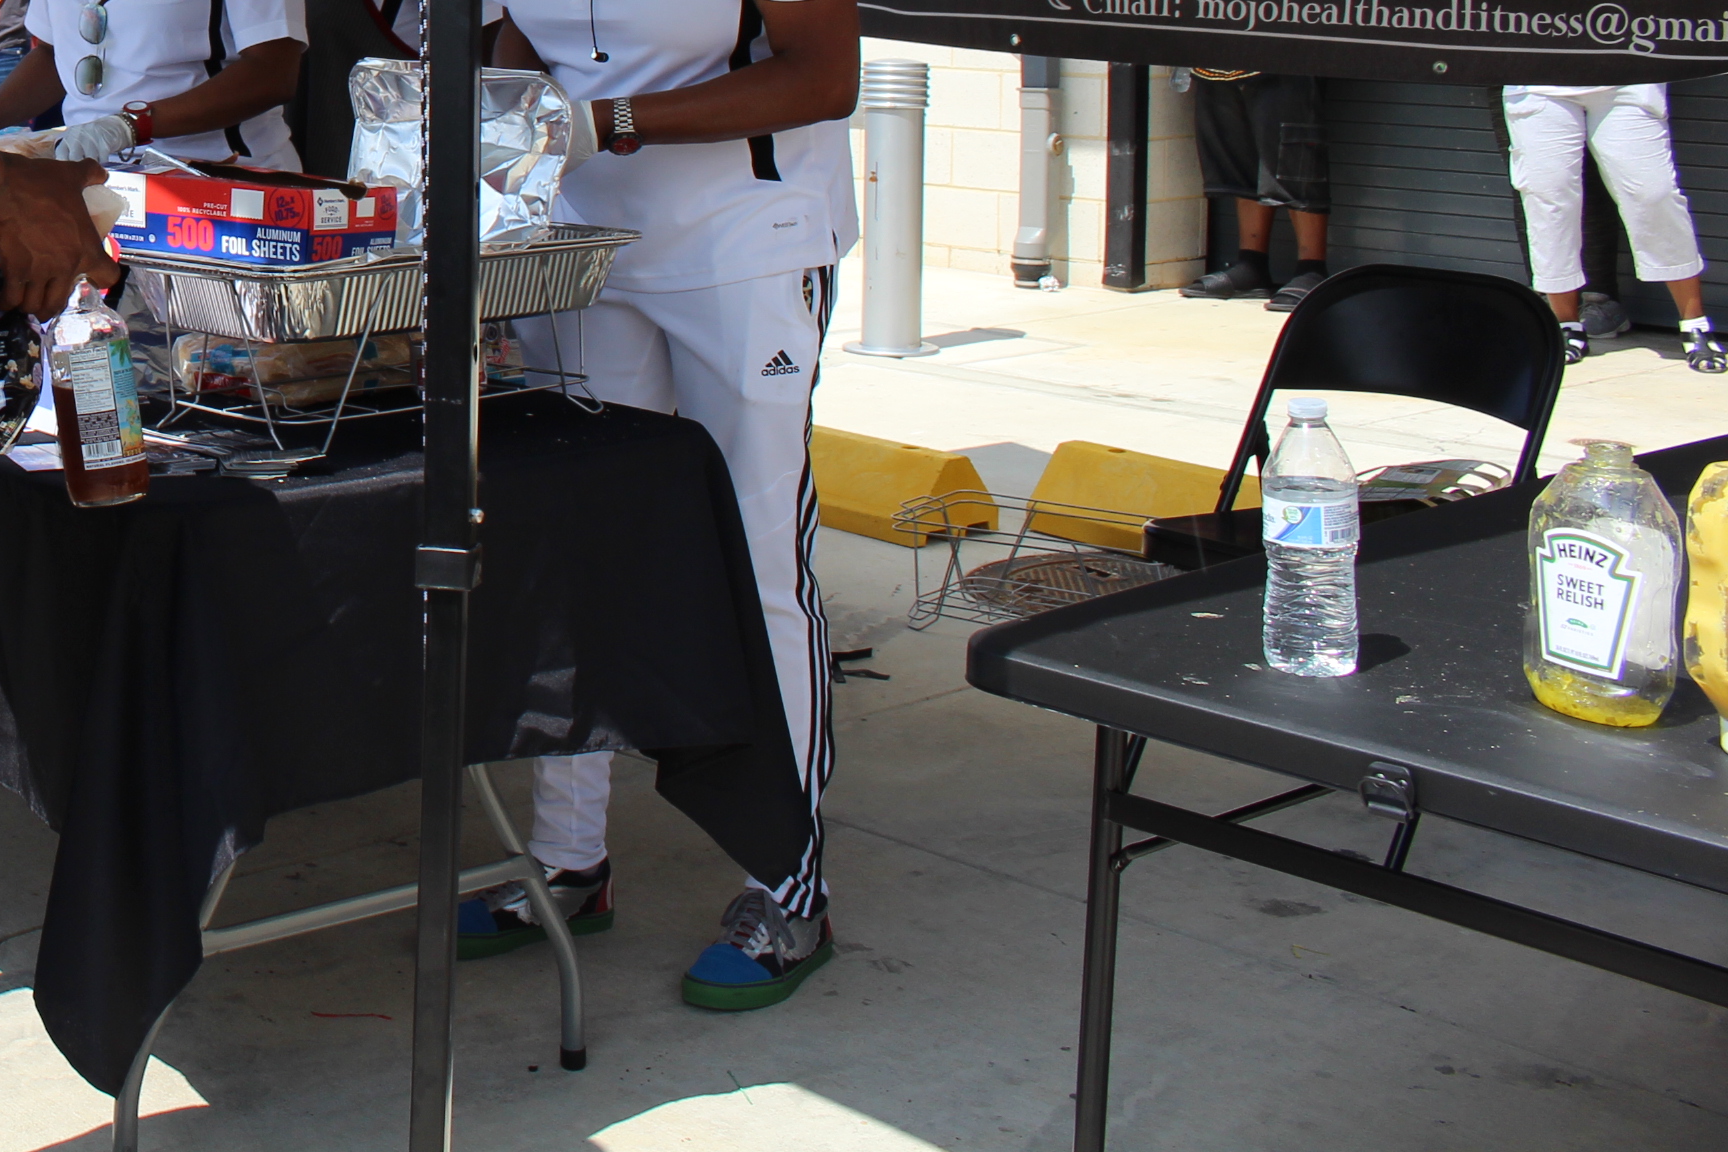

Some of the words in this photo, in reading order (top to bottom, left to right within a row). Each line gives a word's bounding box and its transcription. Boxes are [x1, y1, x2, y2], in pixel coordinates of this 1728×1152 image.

[191, 207, 228, 217] RECYCLABLE
[203, 201, 228, 210] PRE-CUT
[320, 216, 343, 224] SERVICE
[166, 216, 215, 252] 500
[256, 227, 301, 244] ALUMINUM
[221, 235, 250, 256] FOIL
[251, 239, 301, 262] SHEETS
[311, 235, 343, 261] 500
[761, 365, 800, 377] adidas
[1556, 543, 1608, 568] HEINZ
[1556, 573, 1605, 597] SWEET
[1556, 587, 1605, 611] RELISH
